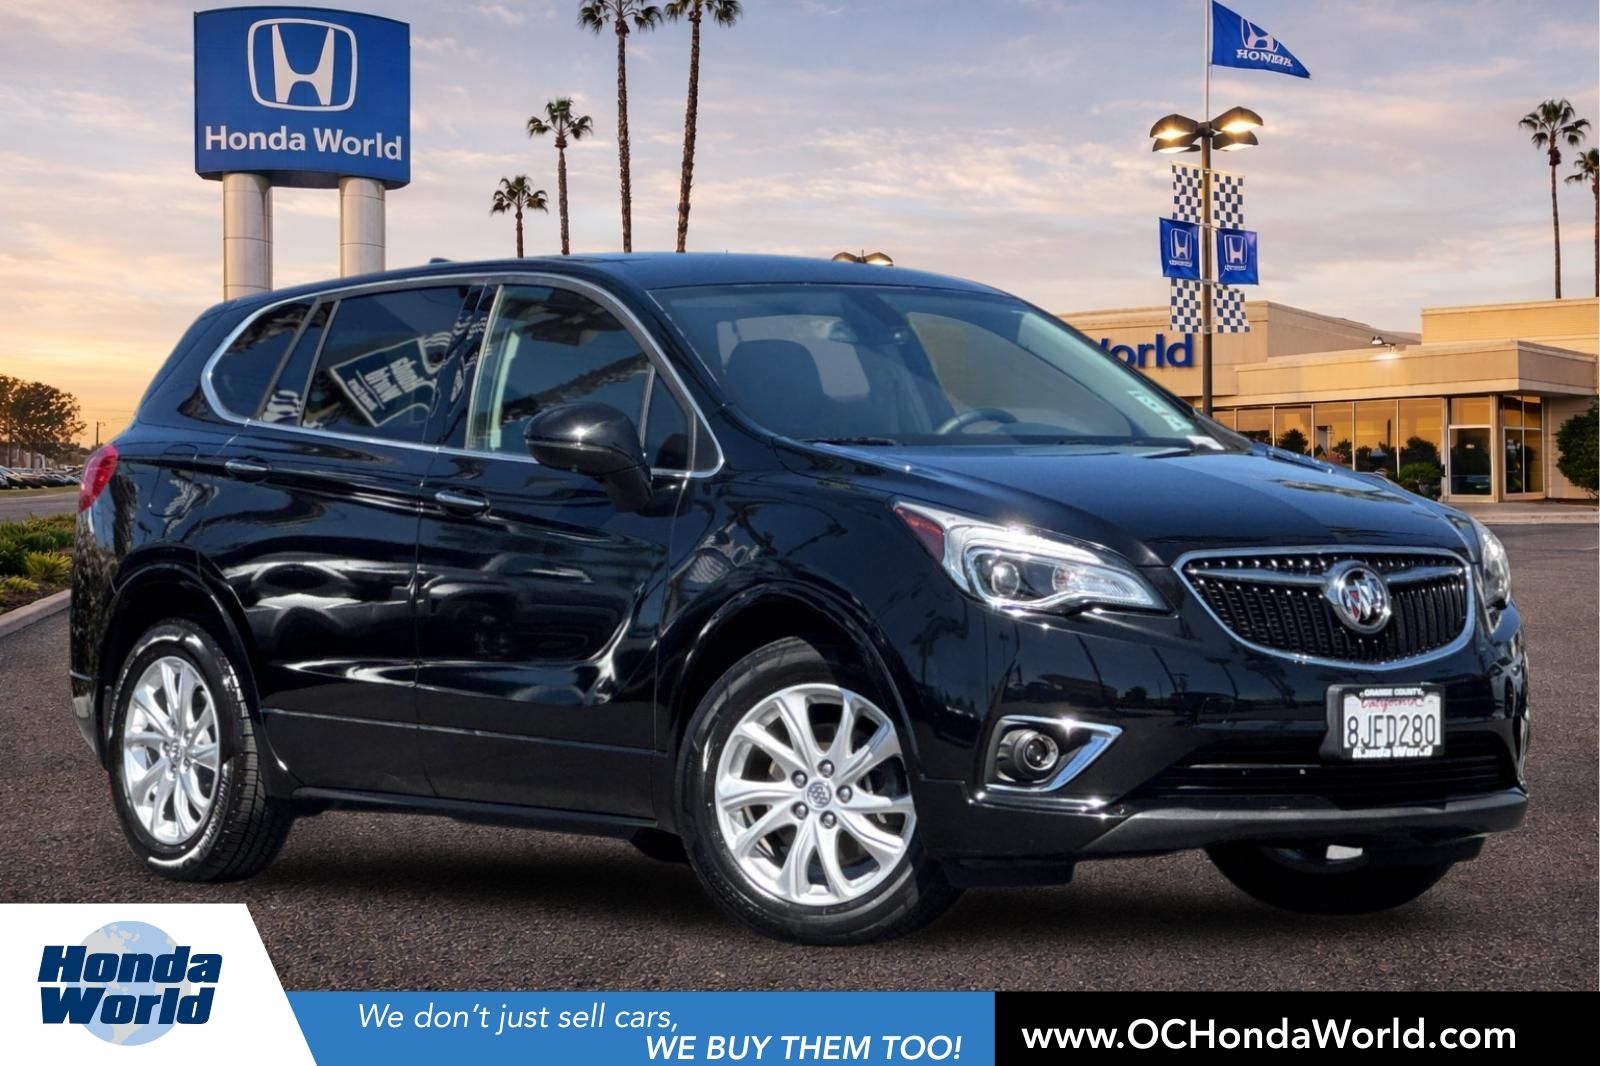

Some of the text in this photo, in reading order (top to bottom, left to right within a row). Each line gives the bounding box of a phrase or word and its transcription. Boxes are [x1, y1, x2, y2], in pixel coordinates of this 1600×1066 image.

[1236, 49, 1293, 67] HONDA
[205, 126, 402, 160] Honda World
[1100, 333, 1194, 368] orld
[1347, 714, 1436, 748] 8JFD280
[1352, 747, 1392, 758] Honda
